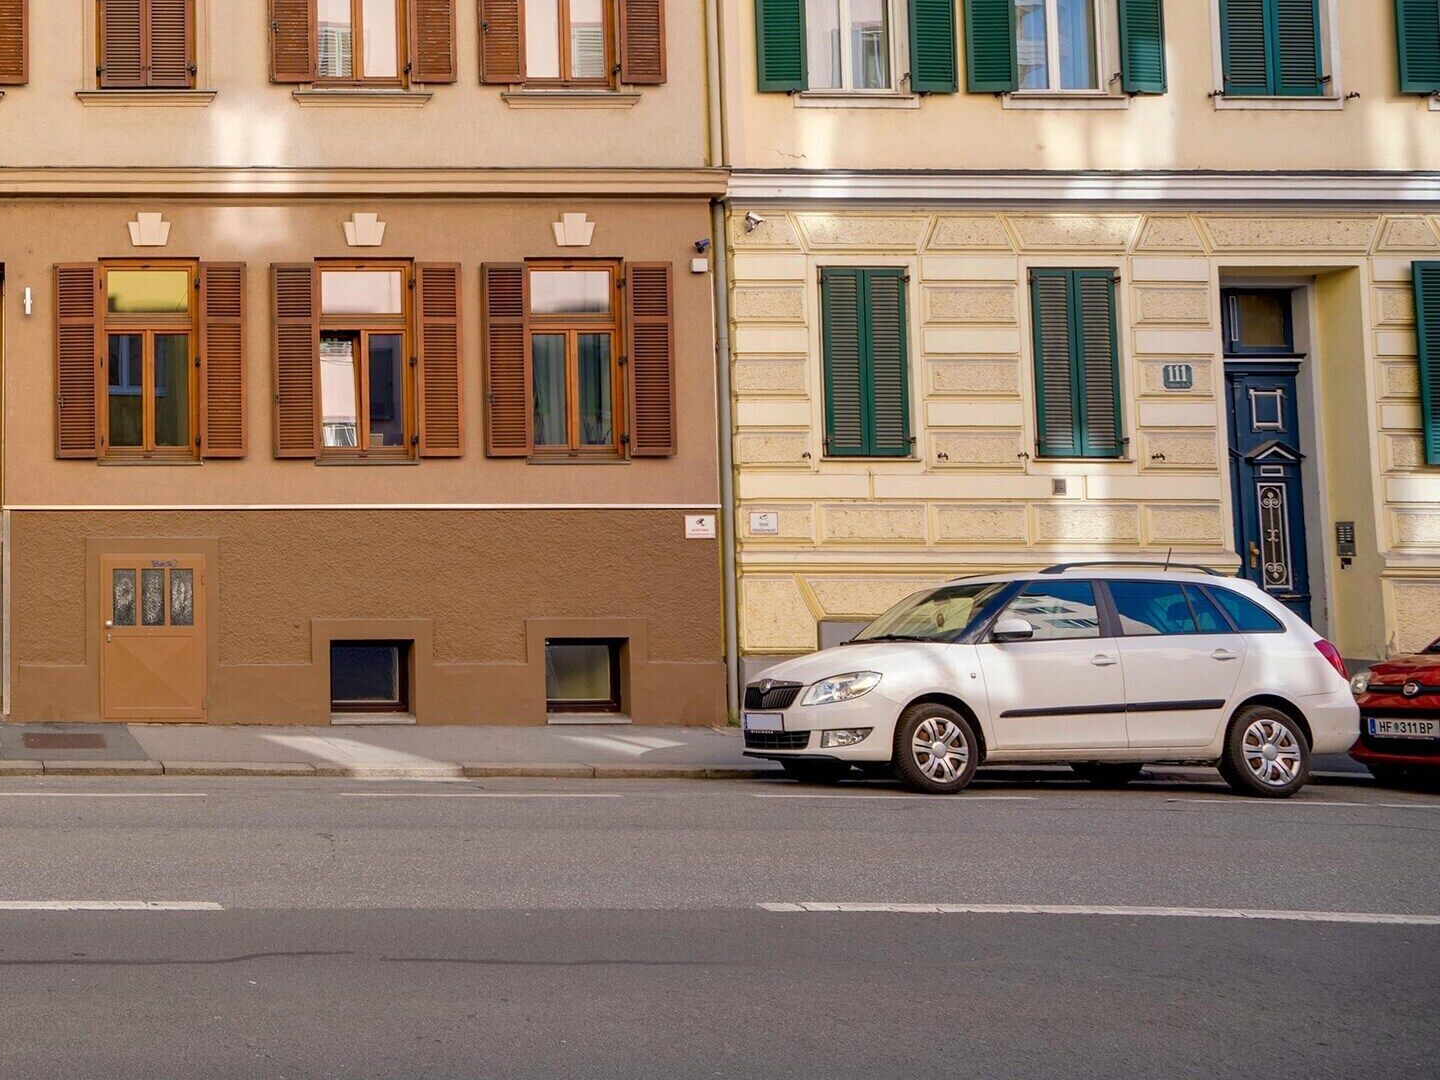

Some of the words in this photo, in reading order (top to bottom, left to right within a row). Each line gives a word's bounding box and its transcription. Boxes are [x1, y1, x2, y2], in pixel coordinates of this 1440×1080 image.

[1168, 365, 1187, 382] 111
[1379, 721, 1392, 733] HF
[1400, 721, 1417, 734] 311
[1419, 722, 1434, 734] BP
